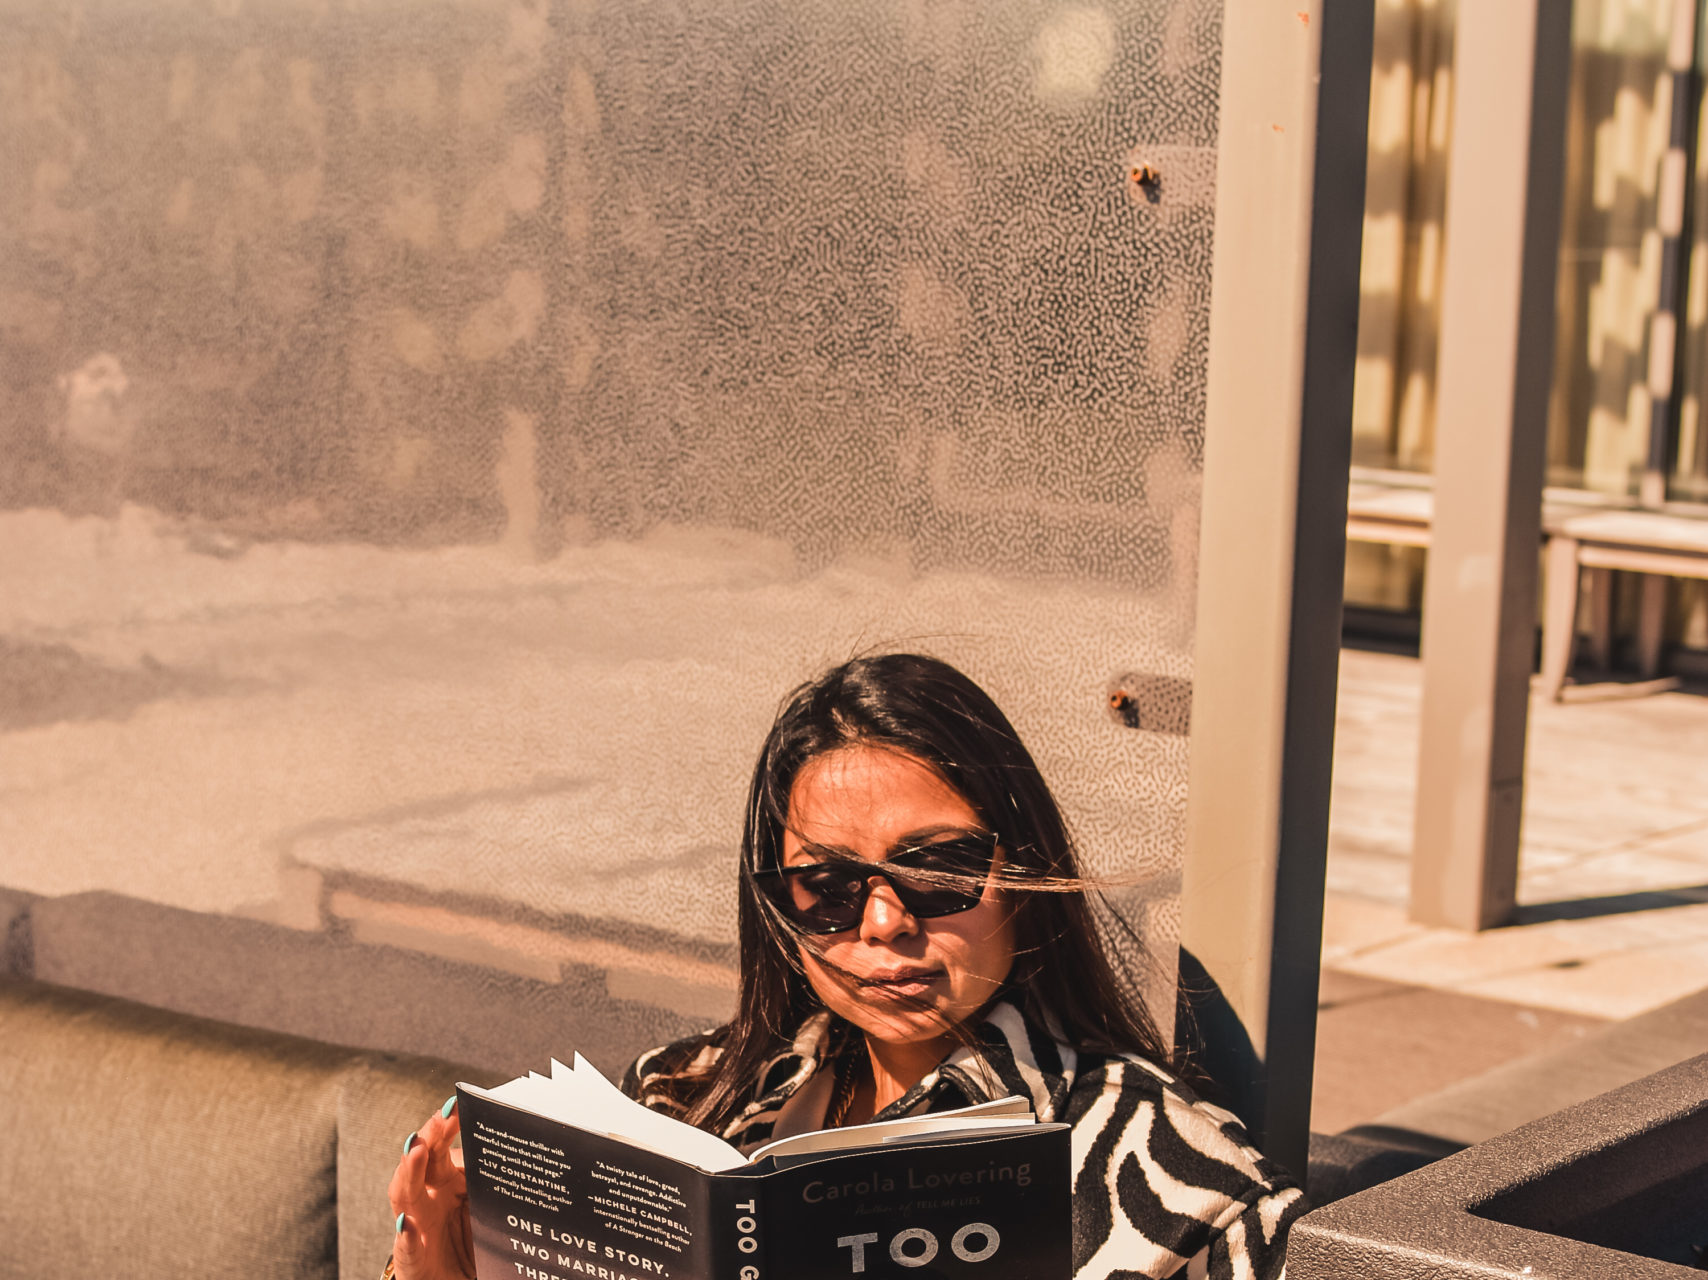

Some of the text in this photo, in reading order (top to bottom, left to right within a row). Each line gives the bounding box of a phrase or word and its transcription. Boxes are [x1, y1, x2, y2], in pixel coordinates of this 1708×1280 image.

[473, 1132, 572, 1170] masterful twists that will leave you
[485, 1126, 529, 1146] cat-and-mouse
[529, 1140, 550, 1152] thriller
[550, 1147, 565, 1157] with
[482, 1147, 507, 1162] guessing
[506, 1156, 521, 1165] until
[521, 1160, 532, 1169] the
[532, 1163, 544, 1173] last
[479, 1167, 573, 1206] internationally bestselling author
[500, 1165, 570, 1195] CONSTANTINE,
[591, 1170, 687, 1208] betrayal, and revenge. Addictive
[605, 1164, 625, 1177] twisty
[625, 1170, 638, 1179] tale
[638, 1174, 646, 1182] of
[646, 1175, 662, 1188] love,
[661, 1183, 681, 1196] greed,
[608, 1188, 621, 1196] and
[802, 1160, 1032, 1204] Carola Lovering
[500, 1186, 511, 1196] The
[511, 1191, 524, 1201] Last
[524, 1195, 538, 1206] Mrs.
[538, 1200, 560, 1212] Parrish
[593, 1206, 690, 1245] internationally bestselling author
[612, 1223, 618, 1231] A
[618, 1225, 645, 1239] Stranger
[653, 1237, 664, 1246] the
[664, 1240, 682, 1253] Beach
[639, 1210, 693, 1237] CAMPBELL,
[736, 1199, 757, 1254] TOO
[506, 1214, 670, 1278] ONE LOVE STORY.
[509, 1237, 550, 1261] TWO
[837, 1222, 1001, 1273] TOO
